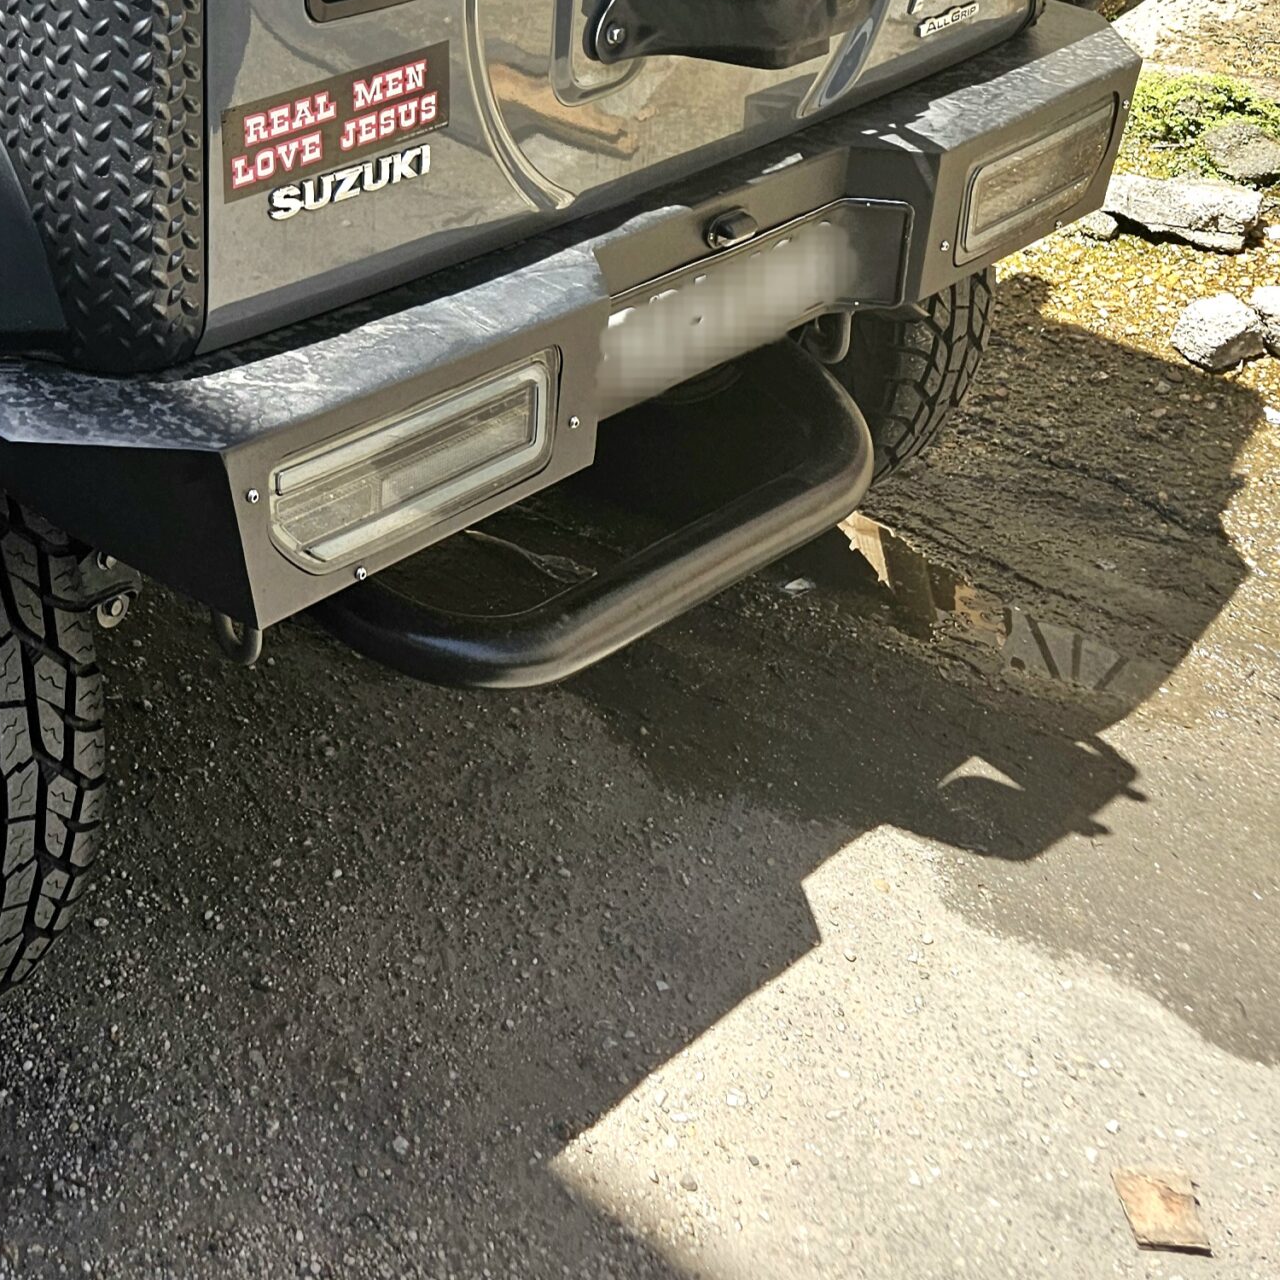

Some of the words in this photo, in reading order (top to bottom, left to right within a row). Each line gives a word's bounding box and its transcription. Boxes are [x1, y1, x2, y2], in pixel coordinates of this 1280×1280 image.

[232, 130, 322, 189] LOVE
[340, 91, 438, 151] JESUS
[244, 91, 337, 147] REAL
[353, 59, 427, 111] MEN
[268, 144, 431, 220] SUZUKI
